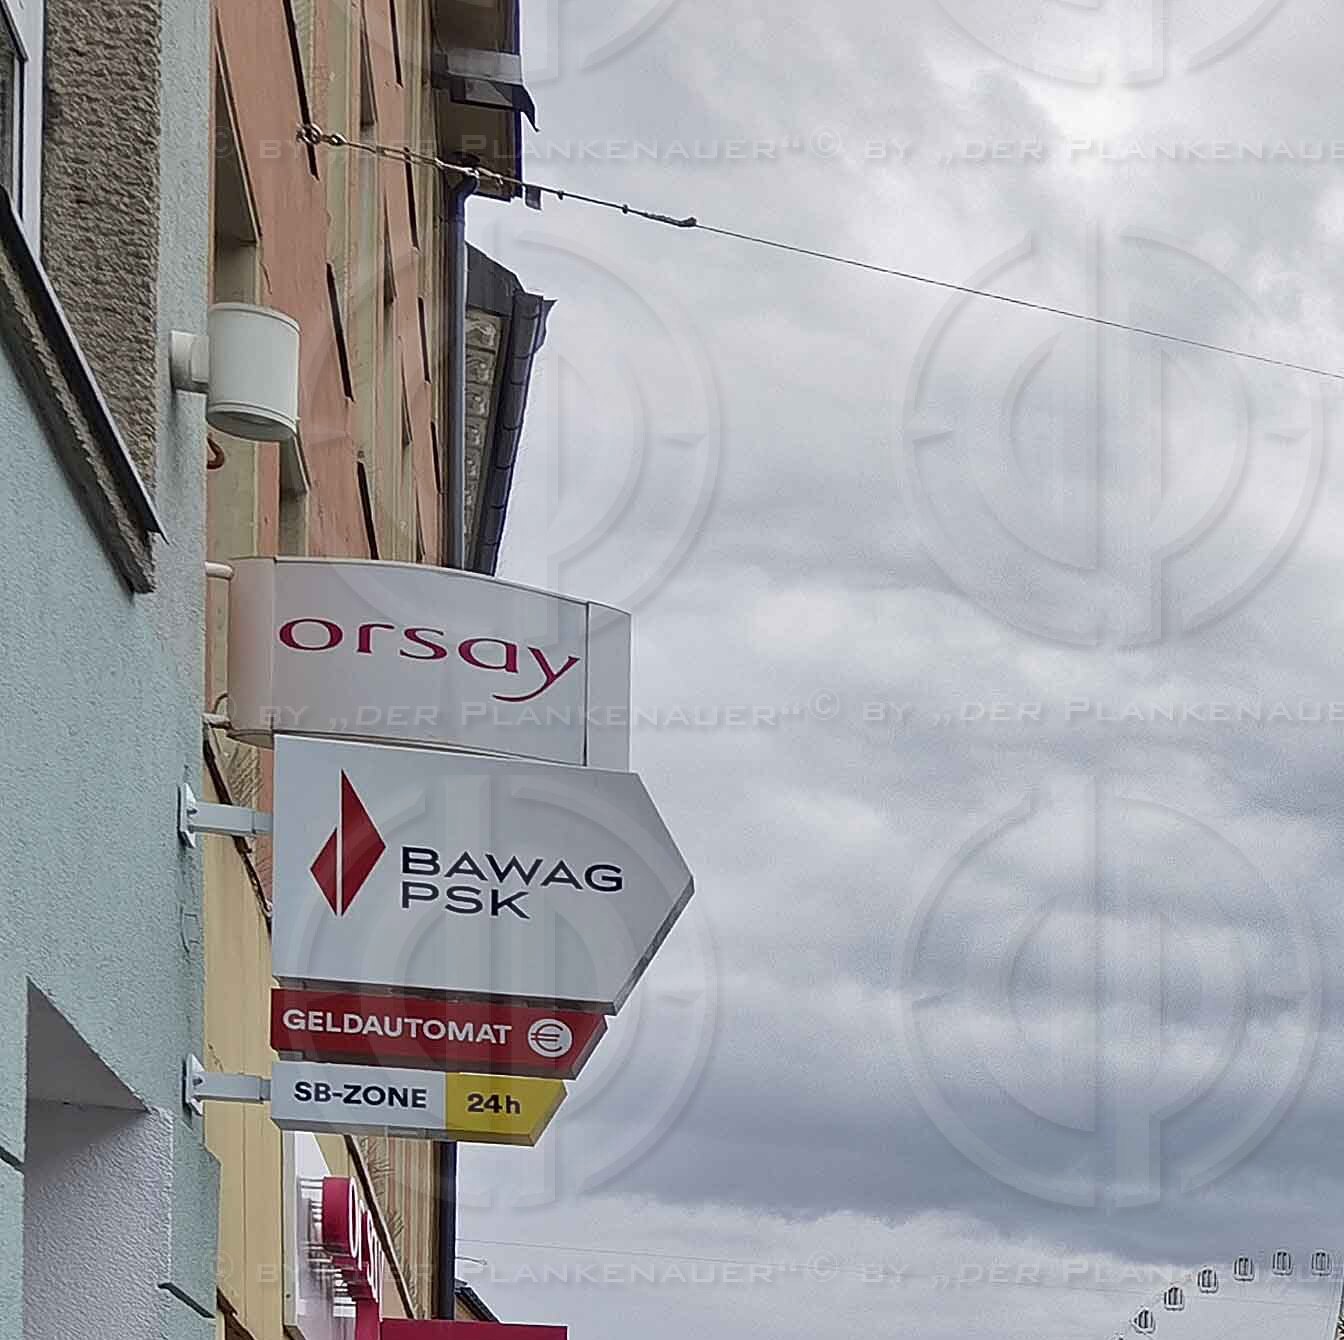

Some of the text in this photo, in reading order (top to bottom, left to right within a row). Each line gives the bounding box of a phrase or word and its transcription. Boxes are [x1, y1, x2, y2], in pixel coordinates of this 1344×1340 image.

[278, 617, 581, 702] orsay
[400, 846, 624, 893] BAWAG
[400, 885, 531, 920] PSK
[283, 1007, 513, 1046] GELDAUTOMAT
[293, 1080, 428, 1110] SB-ZONE
[467, 1091, 521, 1117] 24h
